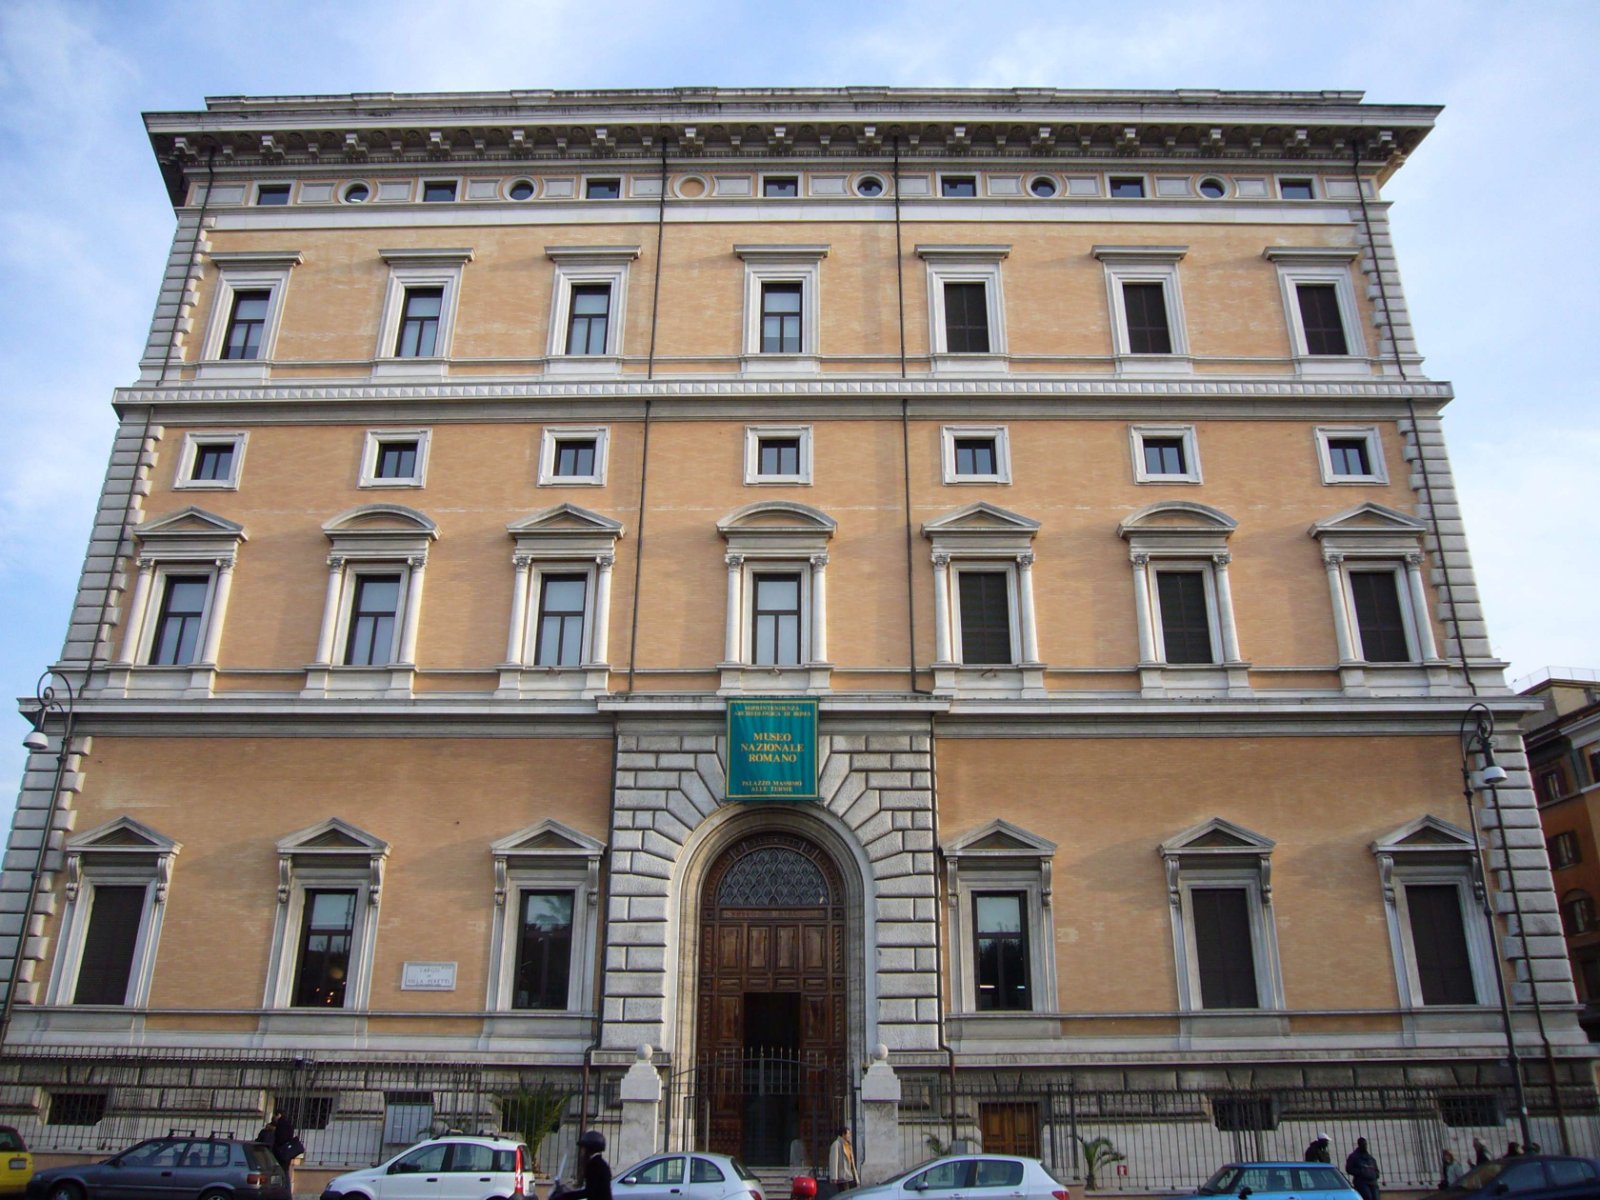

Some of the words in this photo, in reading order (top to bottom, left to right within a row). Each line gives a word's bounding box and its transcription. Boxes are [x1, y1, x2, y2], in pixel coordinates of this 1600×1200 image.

[753, 732, 792, 742] MUSEO
[741, 743, 804, 752] NAZIONALE
[749, 753, 797, 763] ROMANO
